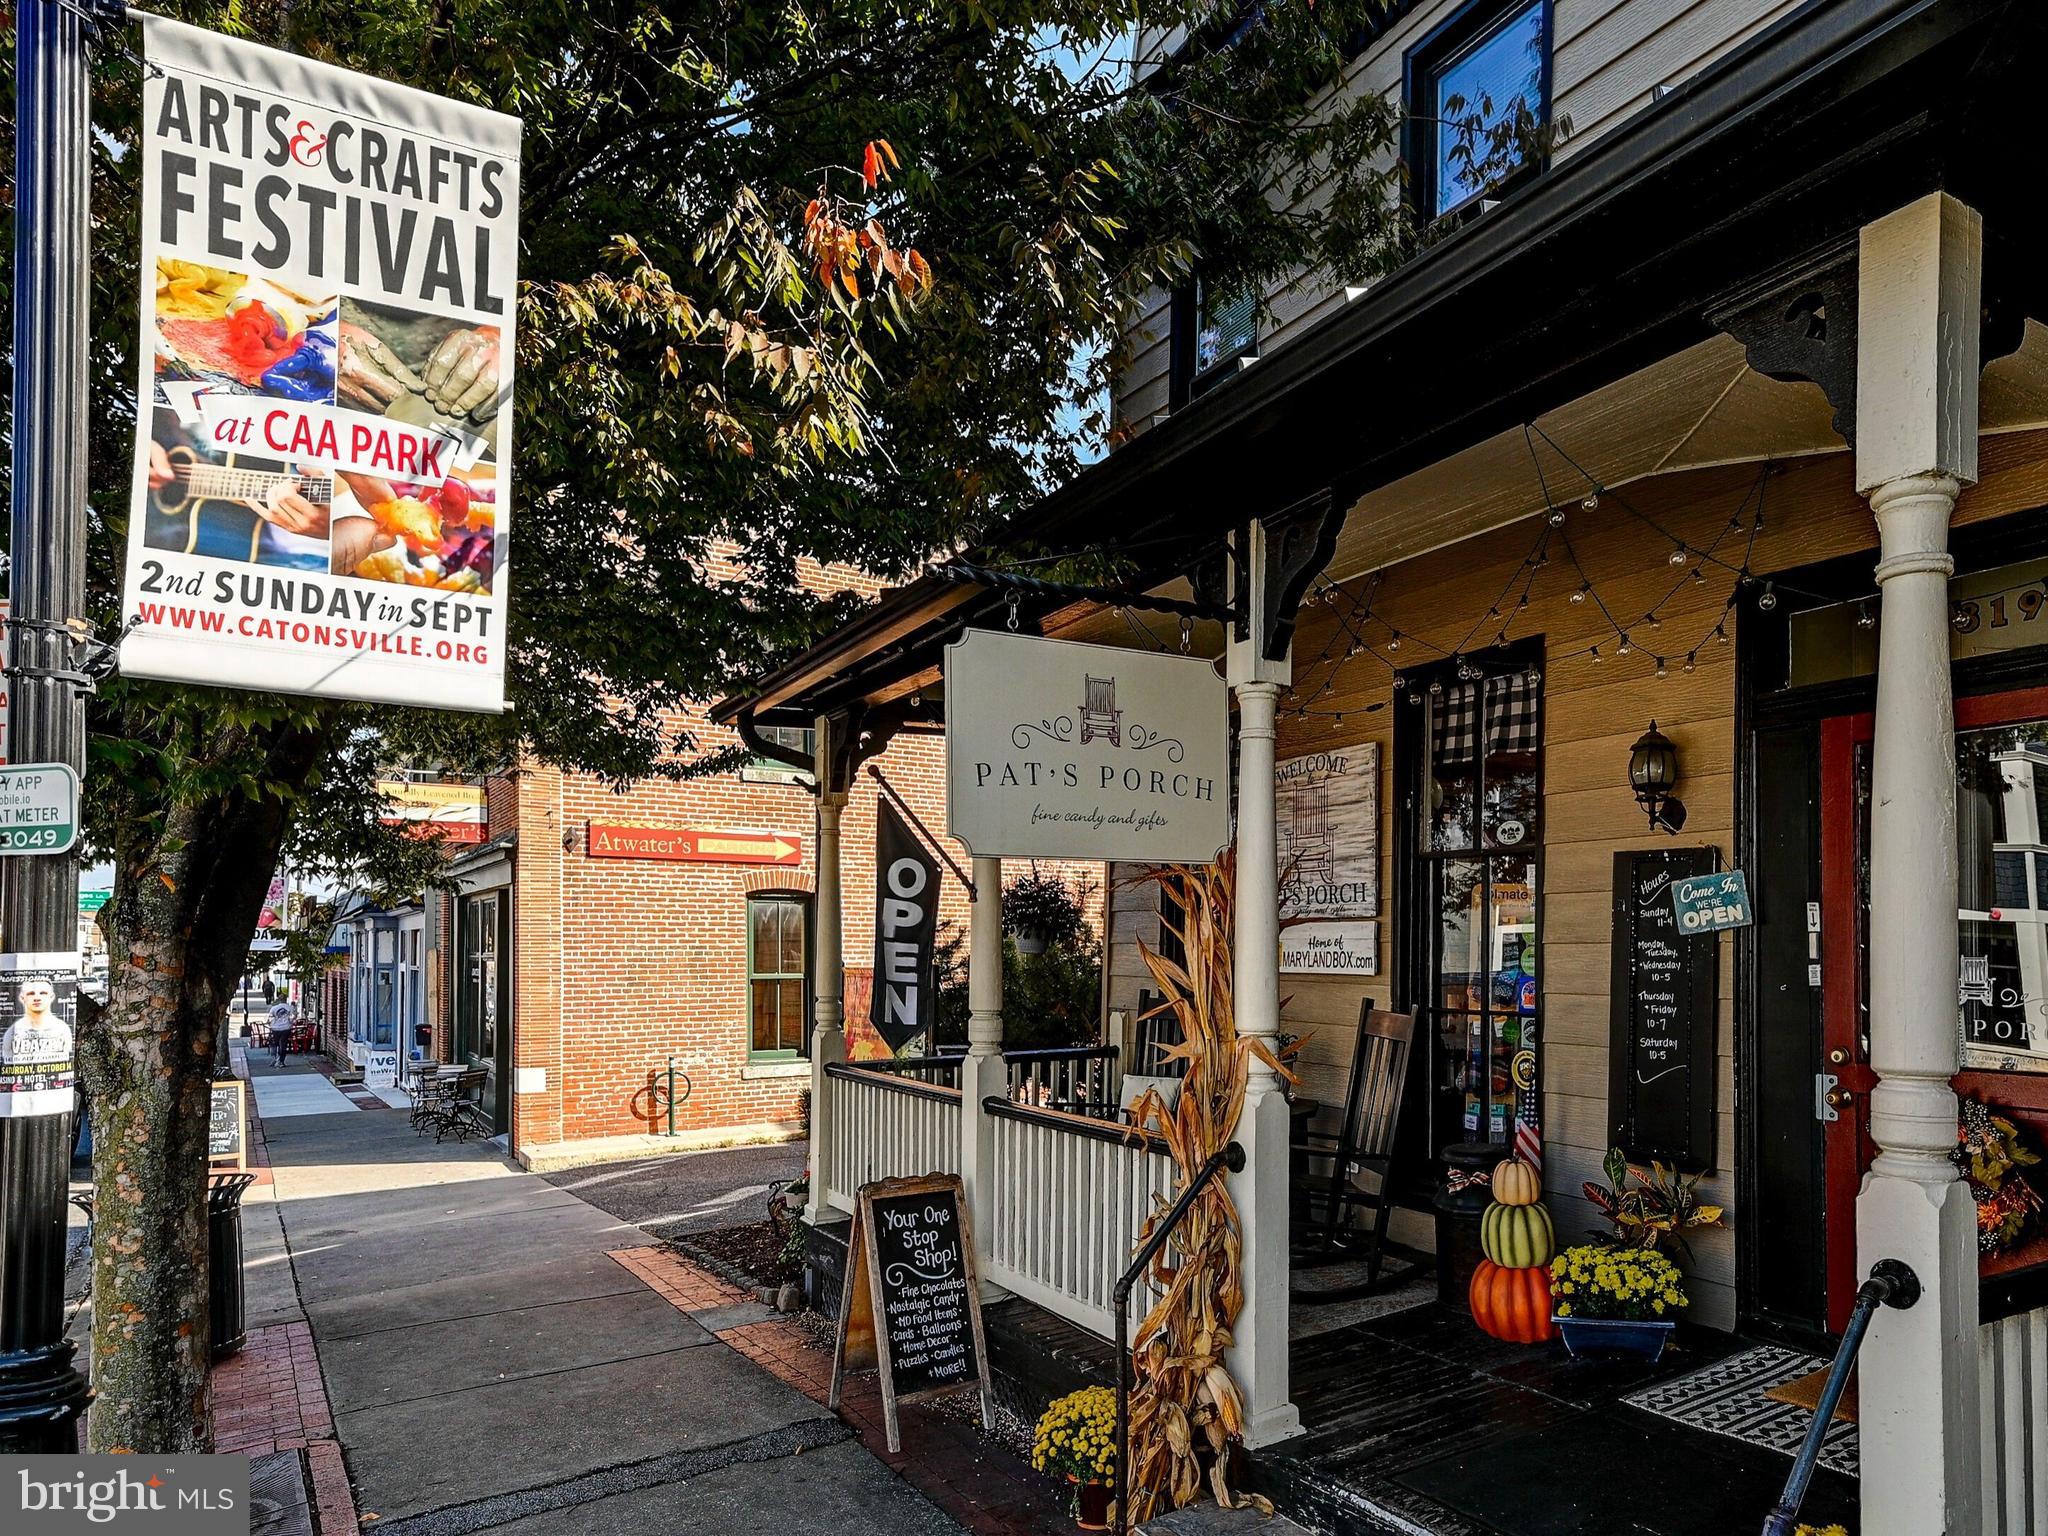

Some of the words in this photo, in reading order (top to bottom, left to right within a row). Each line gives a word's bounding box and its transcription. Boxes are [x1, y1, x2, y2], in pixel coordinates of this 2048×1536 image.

[158, 149, 504, 315] FESTIVAL
[213, 412, 254, 448] at
[263, 409, 340, 461] CAA
[350, 424, 443, 479] PARK
[139, 559, 204, 598] 2nd
[214, 569, 377, 623] SUNDAY
[378, 596, 405, 623] in
[410, 597, 493, 638] SEPT
[137, 601, 489, 666] WWW.CATONSVILLE.ORG
[1276, 754, 1349, 785] WELCOME
[16, 775, 43, 791] APP
[974, 761, 1079, 788] PAT'S
[1099, 765, 1215, 803] PORCH
[16, 807, 59, 823] METER
[1030, 802, 1062, 826] fine
[1064, 807, 1105, 830] candy
[1107, 807, 1136, 826] and
[1135, 809, 1169, 832] gifts
[594, 831, 692, 854] Atwater's
[1306, 882, 1368, 906] PORCH
[1680, 883, 1716, 904] Come
[1718, 876, 1739, 895] In
[1639, 906, 1669, 918] Sunday
[1695, 897, 1723, 910] WE'RE
[1657, 916, 1673, 928] 11-4
[1683, 903, 1744, 929] OPEN
[882, 857, 928, 1026] OPEN
[1308, 935, 1333, 950] Home
[1334, 933, 1345, 951] of
[1282, 949, 1374, 970] MARYLANDBOX.com
[1642, 960, 1681, 971] Wednesday
[1651, 972, 1671, 982] 10-5
[1637, 990, 1675, 1004] Thursday
[1650, 1004, 1677, 1018] Friday
[1646, 1018, 1666, 1031] 10-7
[1639, 1037, 1678, 1051] Saturday
[36, 1063, 65, 1074] OCTOBER
[25, 1074, 47, 1085] HOTEL
[883, 1208, 920, 1231] Your
[924, 1205, 951, 1227] One
[902, 1230, 939, 1251] Stop
[914, 1240, 958, 1273] Shop!
[901, 1284, 920, 1298] Fine
[921, 1277, 966, 1296] Chocolates
[889, 1298, 931, 1314] Nostalgic
[933, 1290, 960, 1307] Candy
[912, 1310, 933, 1325] Food
[934, 1307, 958, 1321] Items
[893, 1328, 915, 1342] Cards
[921, 1320, 963, 1337] Balloons
[902, 1340, 926, 1354] Home
[926, 1334, 952, 1348] Decor
[934, 1343, 965, 1360] Candles
